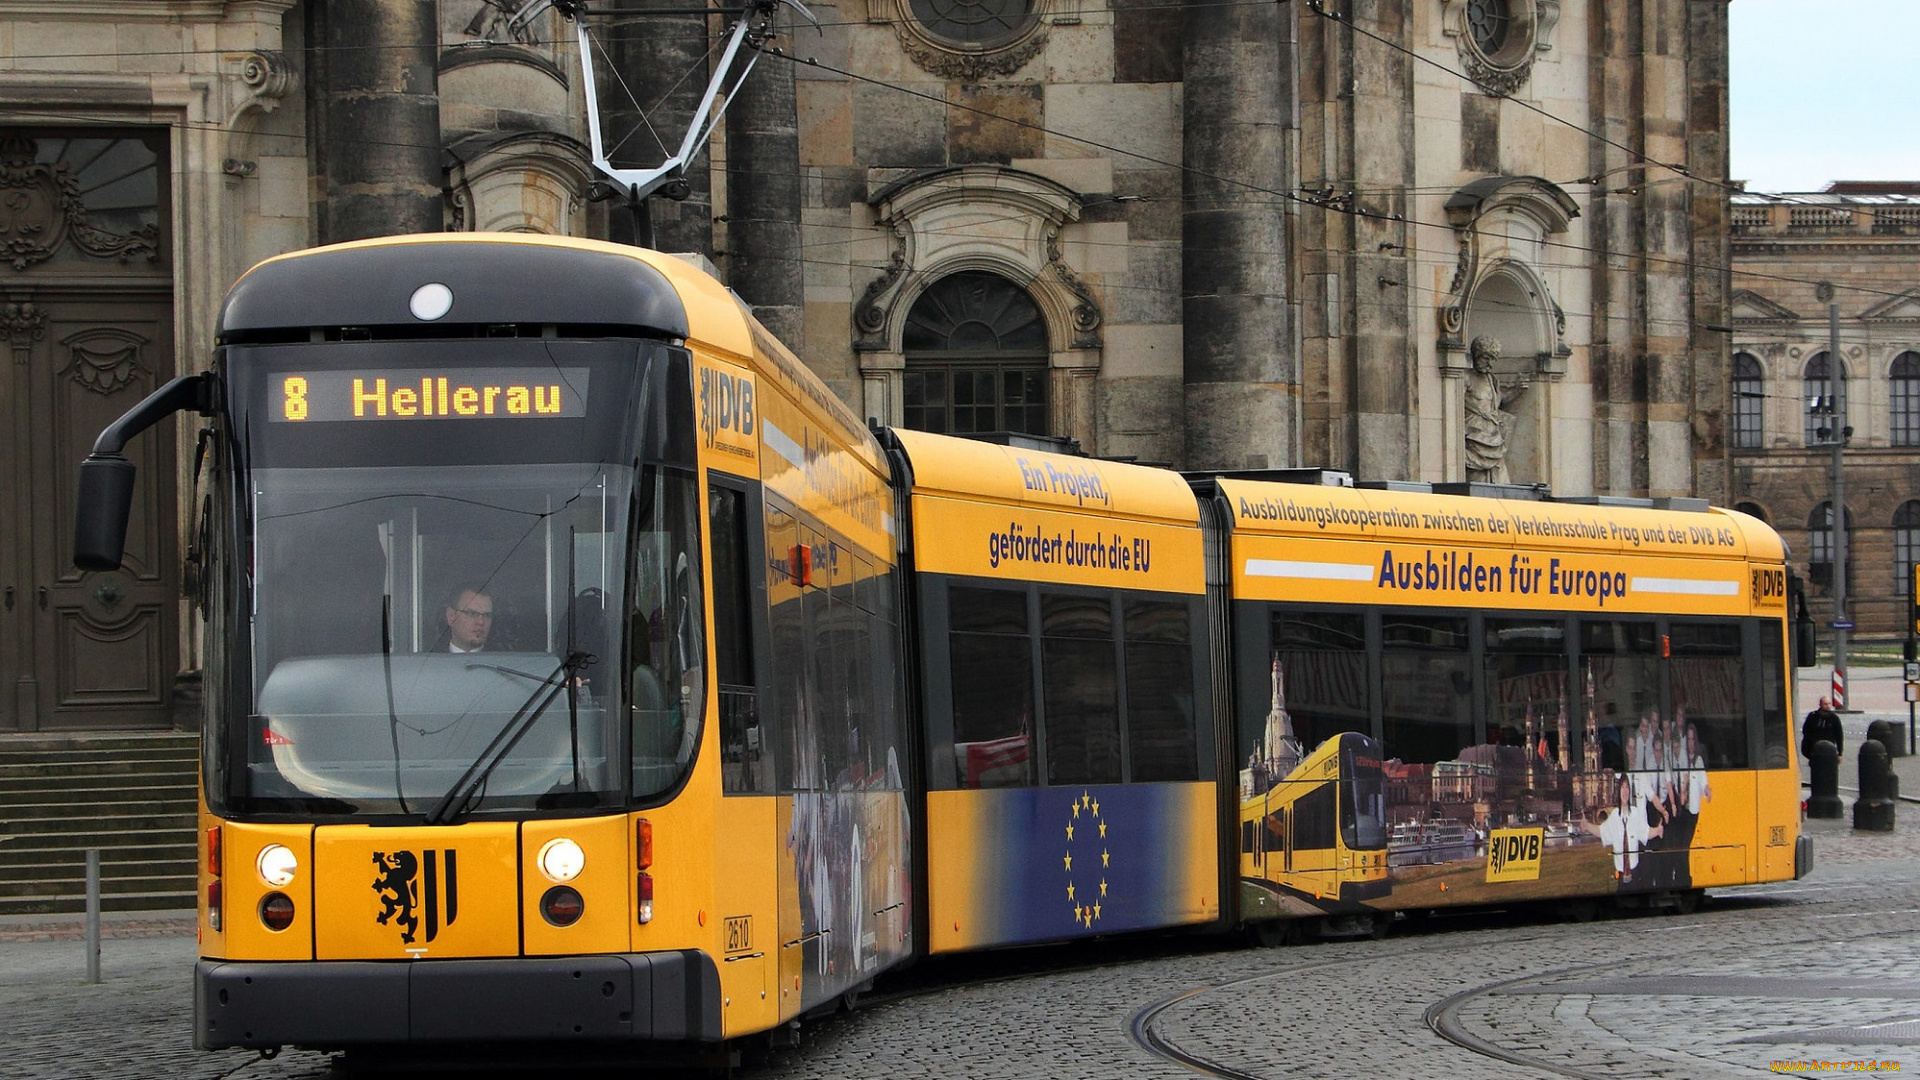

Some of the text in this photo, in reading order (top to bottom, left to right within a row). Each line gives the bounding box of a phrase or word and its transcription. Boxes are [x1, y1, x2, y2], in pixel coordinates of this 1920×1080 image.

[284, 376, 561, 421] 8 Hellerau
[720, 371, 754, 436] DVB
[1016, 457, 1109, 506] Ein Projekt,
[1240, 496, 1735, 548] Ausbildungskooperation zwischen der Verkehrsschule Prag und der DVB AG
[989, 522, 1150, 573] gefördert durch die EU
[1378, 549, 1627, 606] Ausbilden für Europa
[1763, 569, 1784, 597] DVB
[1507, 834, 1540, 862] DVB
[728, 919, 749, 949] 2610
